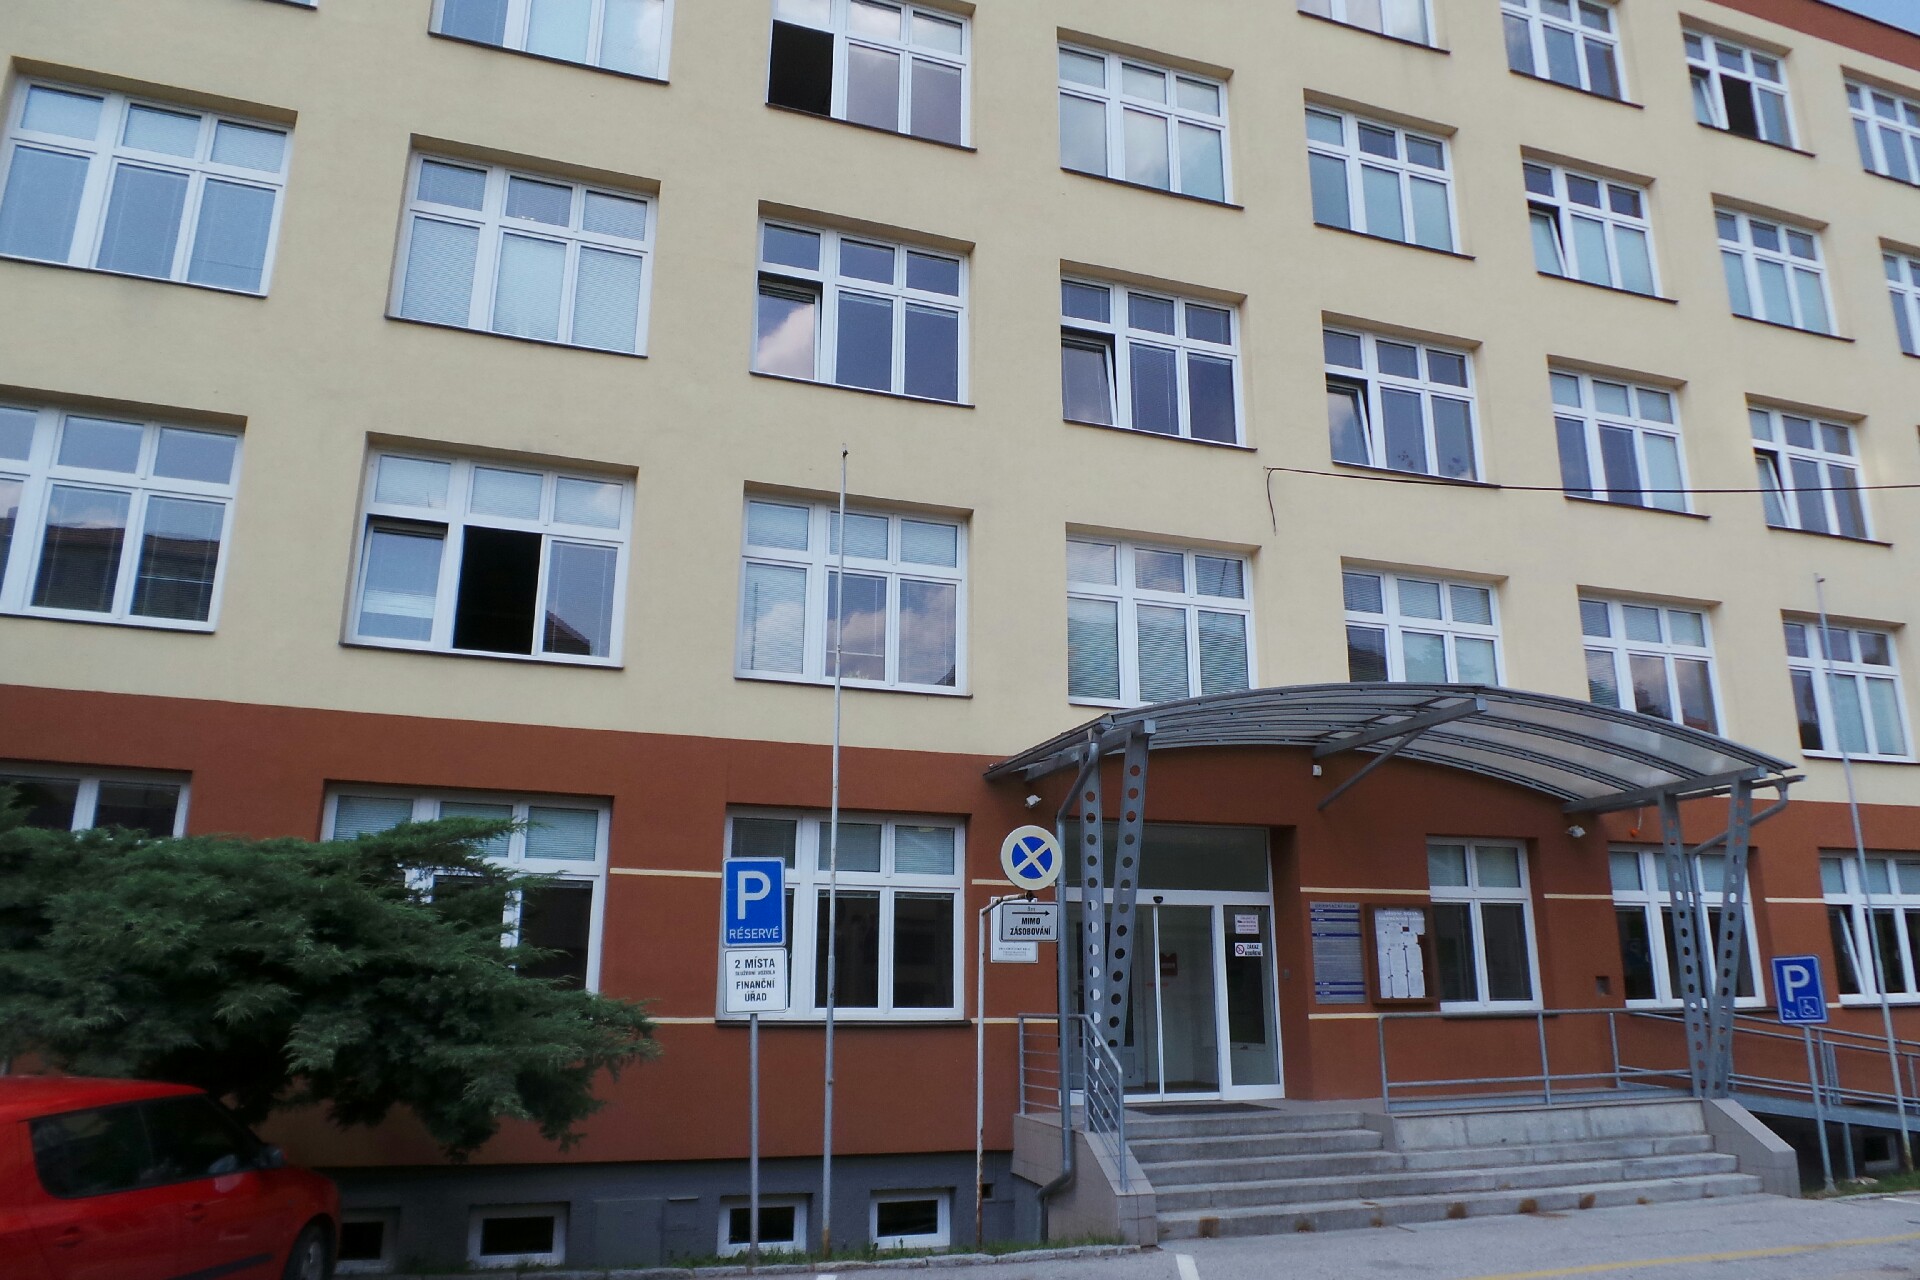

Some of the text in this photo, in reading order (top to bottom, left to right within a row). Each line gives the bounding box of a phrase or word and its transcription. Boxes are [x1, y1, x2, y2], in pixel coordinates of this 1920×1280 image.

[737, 870, 771, 920] P
[1021, 917, 1041, 925] MIMO
[729, 926, 779, 939] RÉSERVÉ
[1010, 926, 1051, 935] ZÁSOBOVÁNÍ
[734, 956, 776, 969] 2 MÍSTA
[736, 978, 776, 990] FINANČNÍ
[1782, 965, 1810, 1002] P
[744, 991, 767, 1002] ÚŘAD
